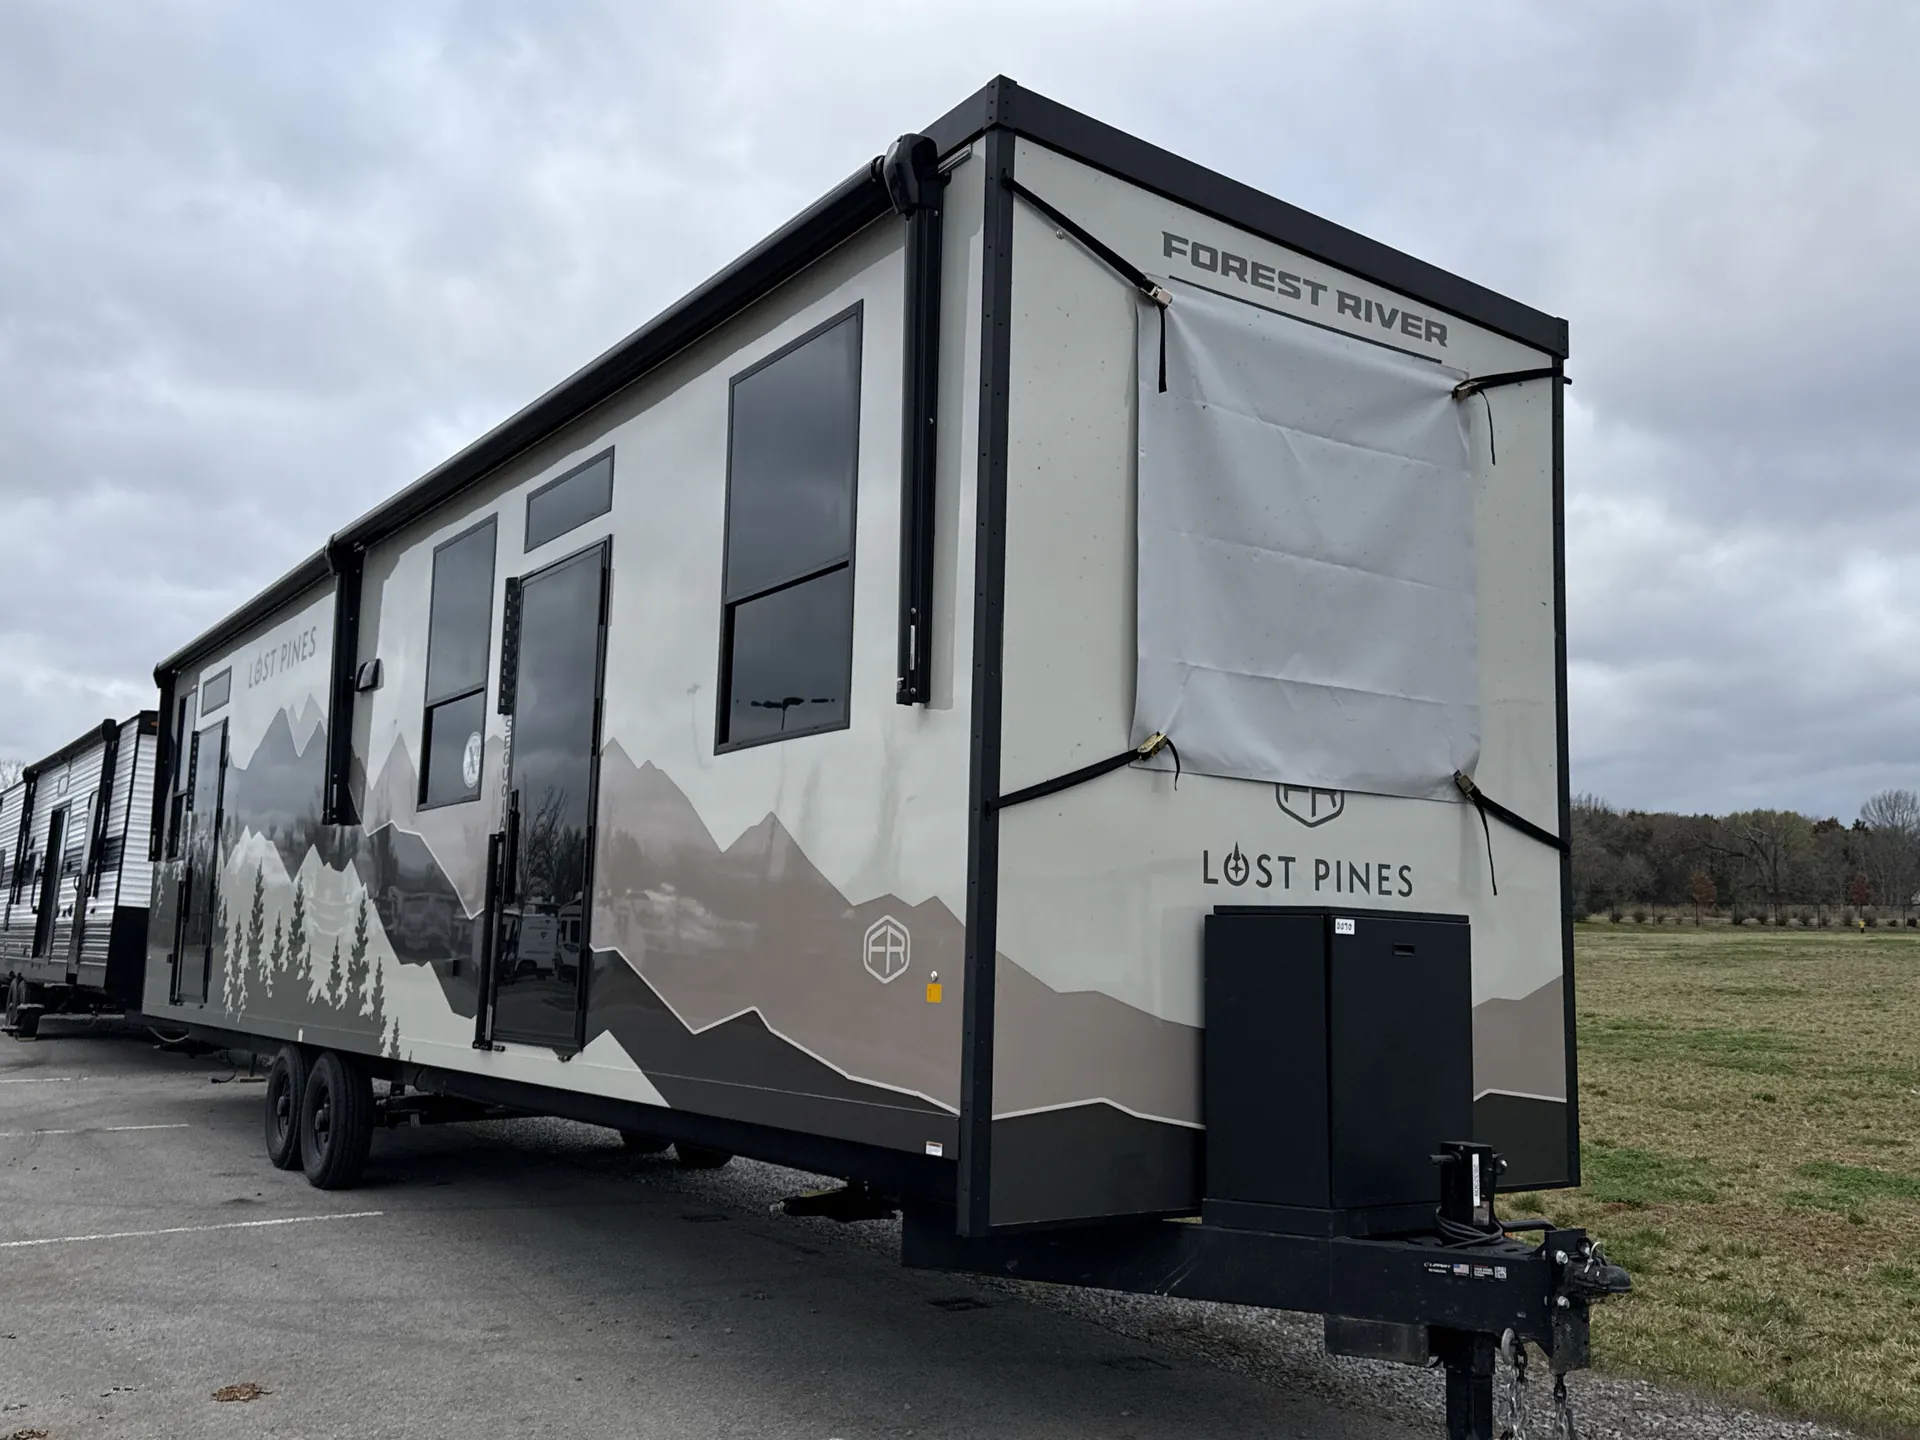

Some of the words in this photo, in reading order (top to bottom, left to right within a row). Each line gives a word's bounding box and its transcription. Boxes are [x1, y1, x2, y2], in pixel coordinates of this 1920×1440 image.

[1162, 231, 1328, 306] FOREST
[1336, 289, 1448, 348] RIVER
[248, 647, 278, 689] LOST
[280, 626, 317, 672] PINES
[1203, 842, 1296, 889] LOST
[1314, 859, 1413, 898] PINES
